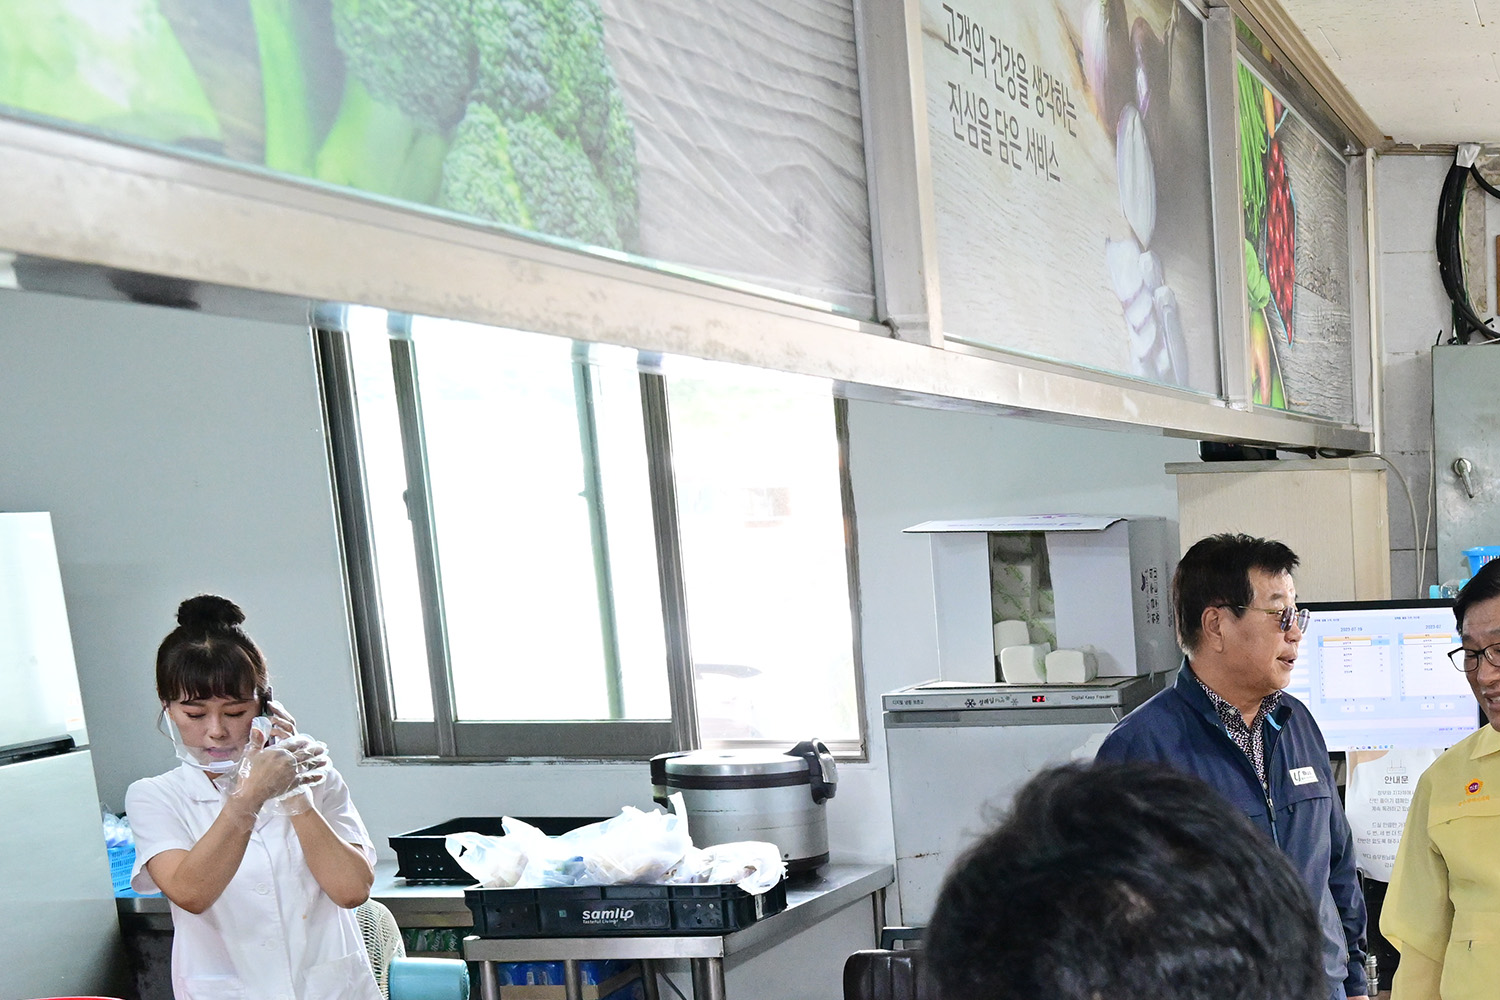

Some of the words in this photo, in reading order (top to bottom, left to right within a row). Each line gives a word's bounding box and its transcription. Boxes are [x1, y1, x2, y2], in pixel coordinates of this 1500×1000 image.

[943, 3, 987, 78] 고객의
[990, 35, 1029, 109] 건강을
[1032, 65, 1077, 138] 생각하는
[948, 81, 992, 156] 진심을
[995, 108, 1022, 170] 담은
[1026, 127, 1060, 182] 서비스
[1384, 776, 1408, 784] 안내문
[582, 908, 634, 921] samlip
